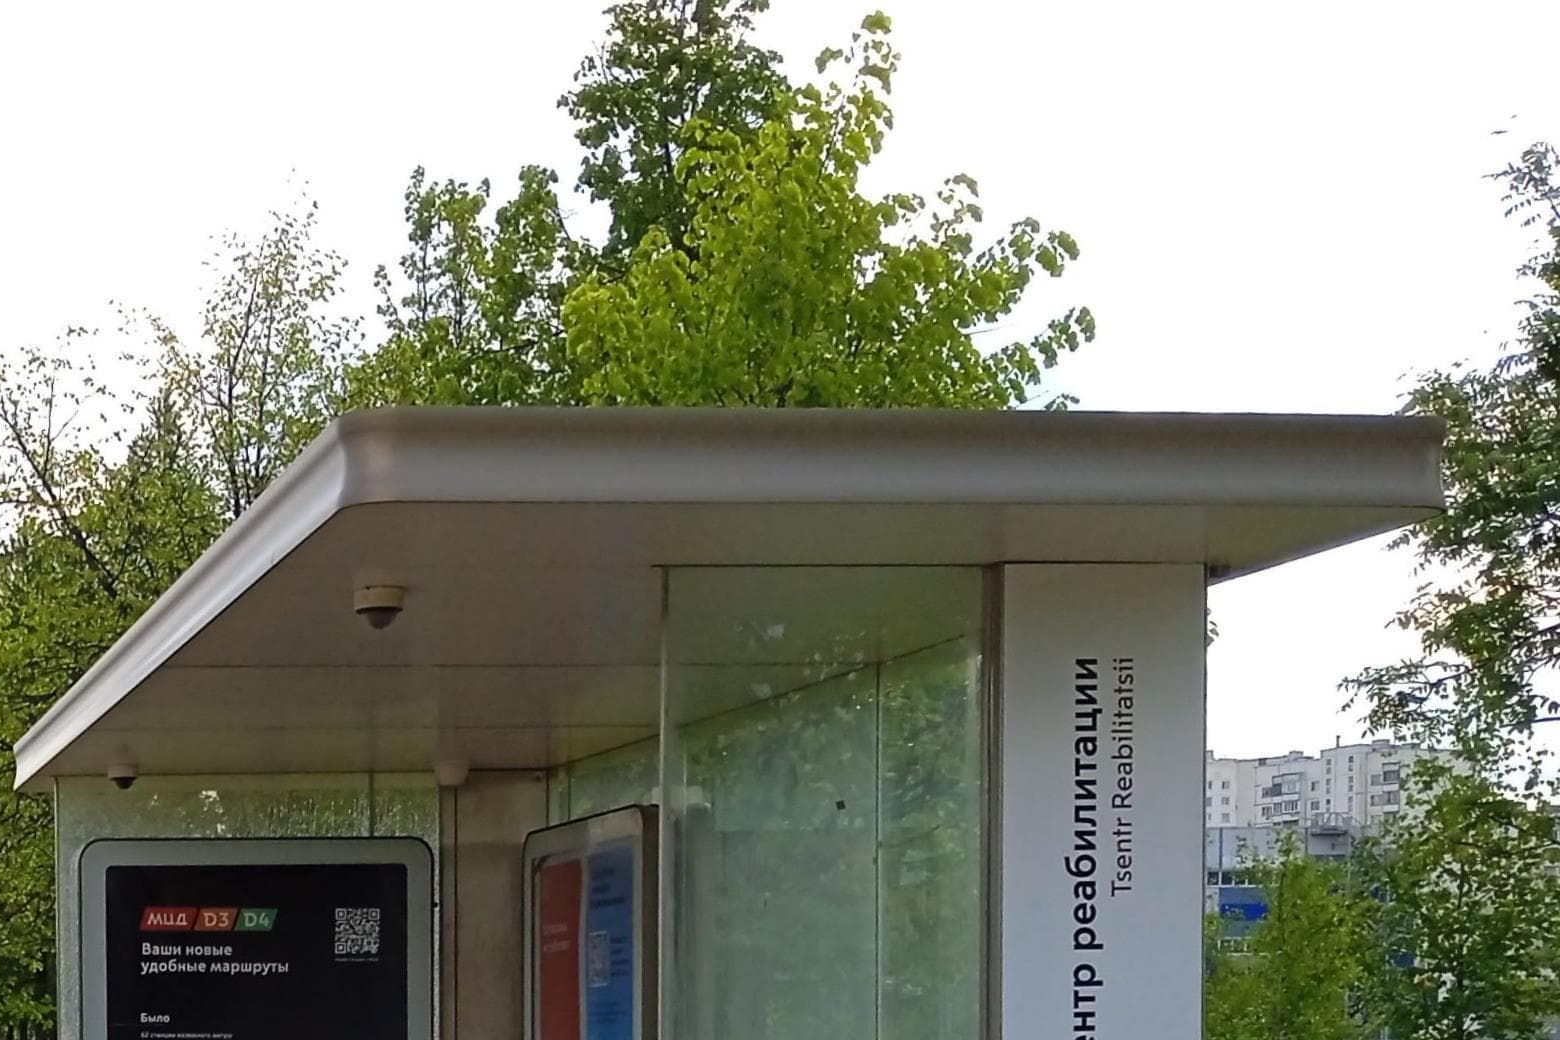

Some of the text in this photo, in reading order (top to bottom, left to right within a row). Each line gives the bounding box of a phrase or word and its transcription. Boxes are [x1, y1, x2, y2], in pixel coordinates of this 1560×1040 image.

[1111, 657, 1134, 897] Tsentr Reabilitatsii
[1064, 658, 1104, 950] реабилитации
[146, 912, 270, 928] МЦД D3 D4
[141, 942, 233, 956] Ваши новые
[140, 959, 289, 975] удобные маршруты
[140, 1012, 170, 1023] Было
